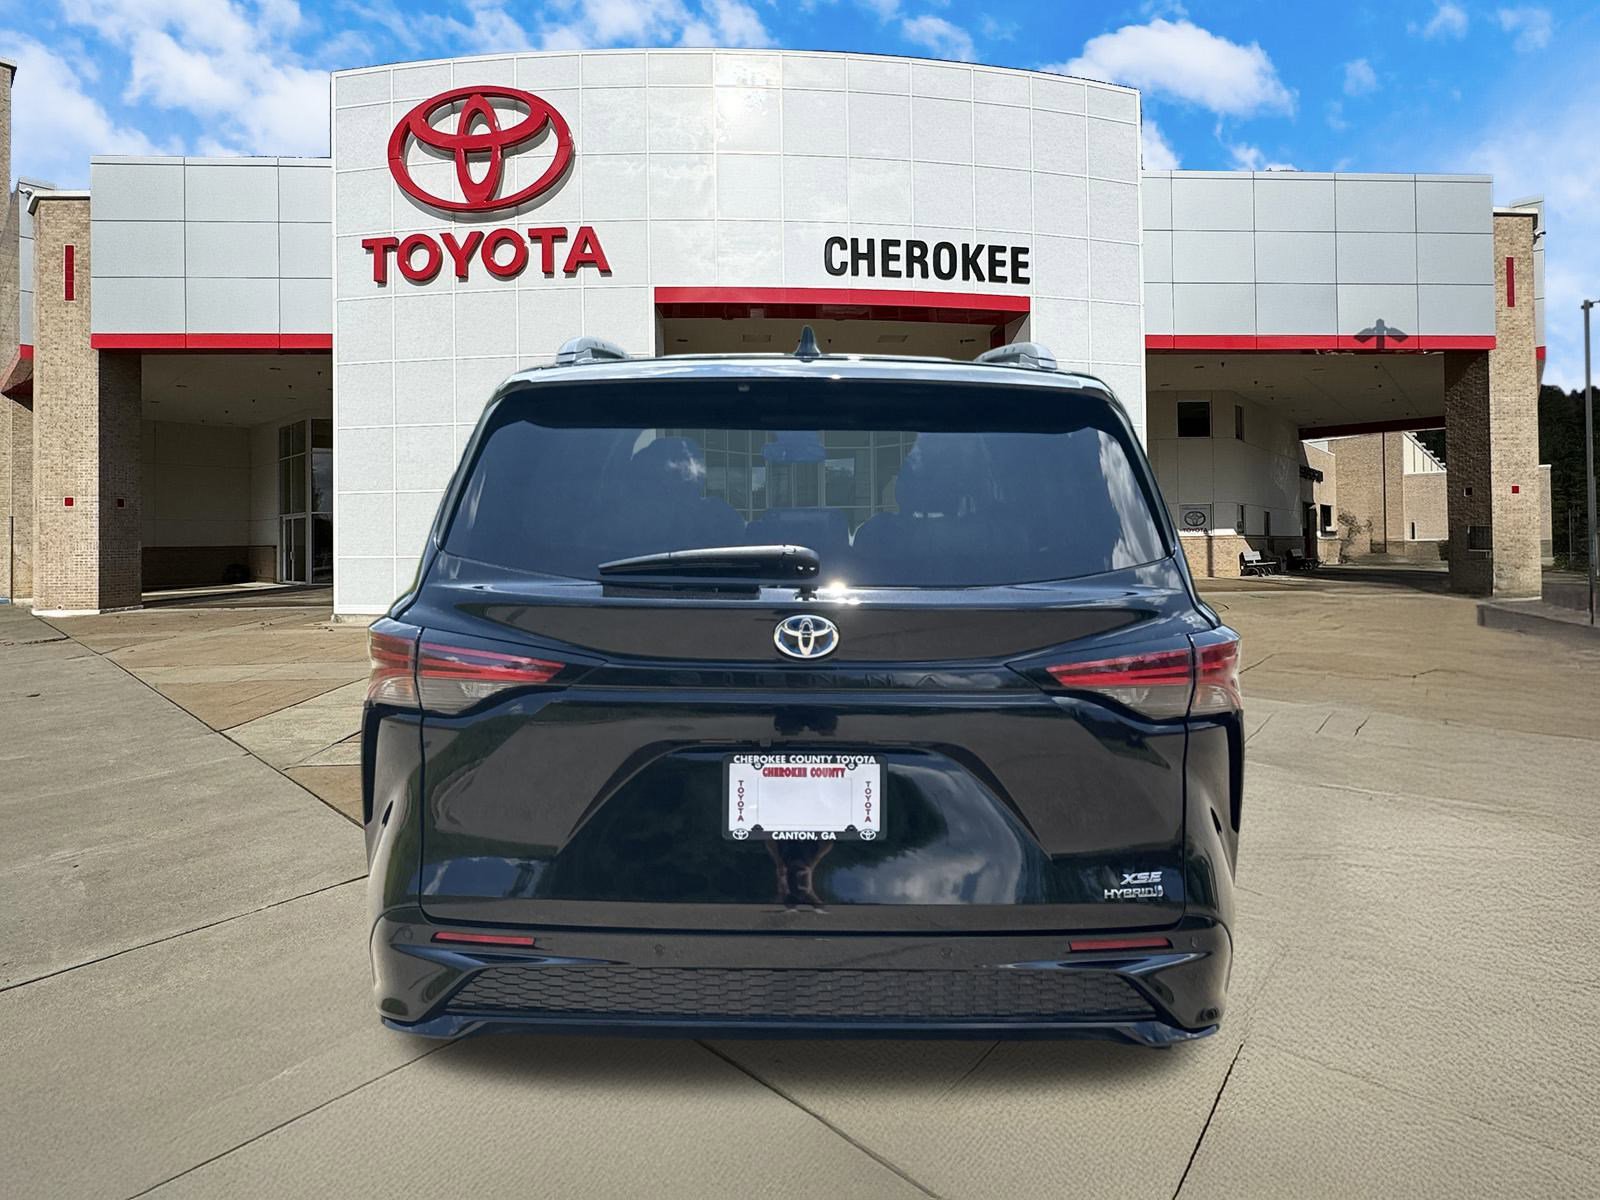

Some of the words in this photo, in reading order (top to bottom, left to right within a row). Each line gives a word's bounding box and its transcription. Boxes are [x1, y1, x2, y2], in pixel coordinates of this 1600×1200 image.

[362, 226, 612, 287] TOYOTA
[824, 236, 1031, 285] CHEROKEE
[733, 755, 786, 764] CHEROKEE
[789, 755, 833, 764] COUNTY
[836, 755, 876, 764] TOYOTA
[762, 767, 807, 778] CHEROKEE
[810, 767, 846, 778] COUNTY
[737, 780, 745, 822] TOYOTA
[864, 781, 872, 823] TOYOTA
[772, 831, 818, 841] CANTON,
[821, 831, 836, 840] GA
[1120, 872, 1162, 885] XSE
[1104, 888, 1154, 899] HYBRID
